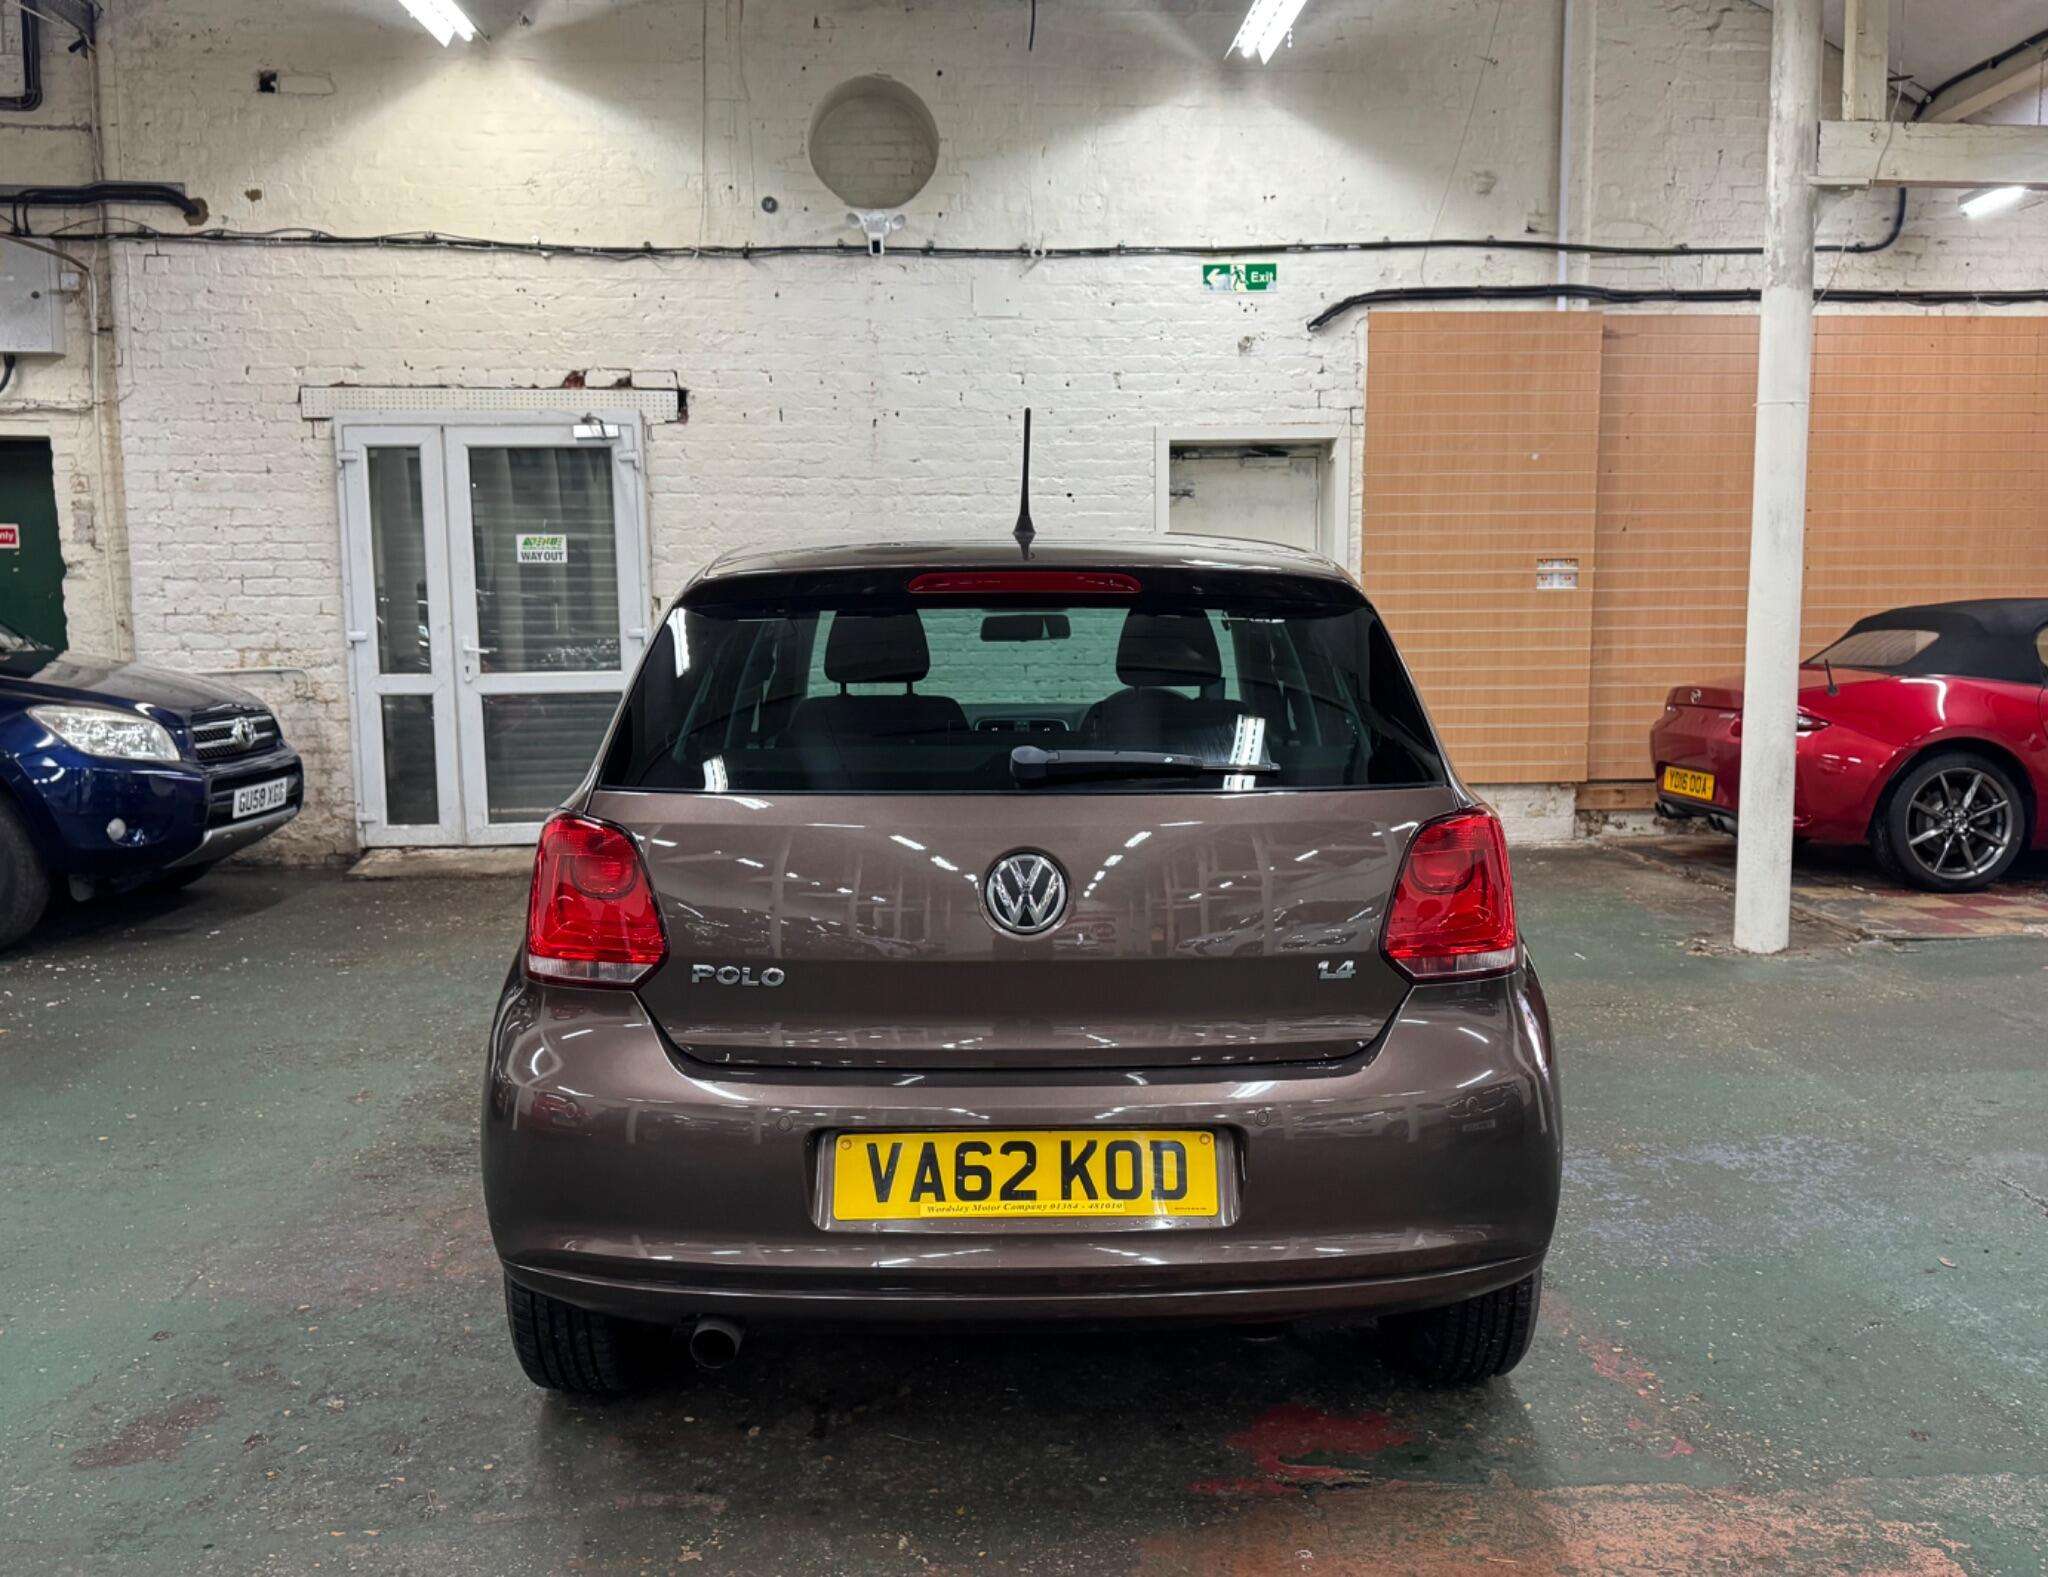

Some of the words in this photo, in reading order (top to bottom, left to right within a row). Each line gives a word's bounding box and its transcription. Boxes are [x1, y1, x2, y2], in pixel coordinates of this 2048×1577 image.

[1251, 271, 1273, 283] Exit
[0, 531, 14, 542] nly
[520, 551, 542, 561] WAY
[544, 551, 564, 561] OUT
[239, 788, 266, 812] GU58
[691, 964, 785, 987] POLO
[866, 1140, 1037, 1203] VA62
[1060, 1139, 1188, 1201] KOD
[973, 1203, 1001, 1212] Motor
[1003, 1202, 1047, 1211] Company
